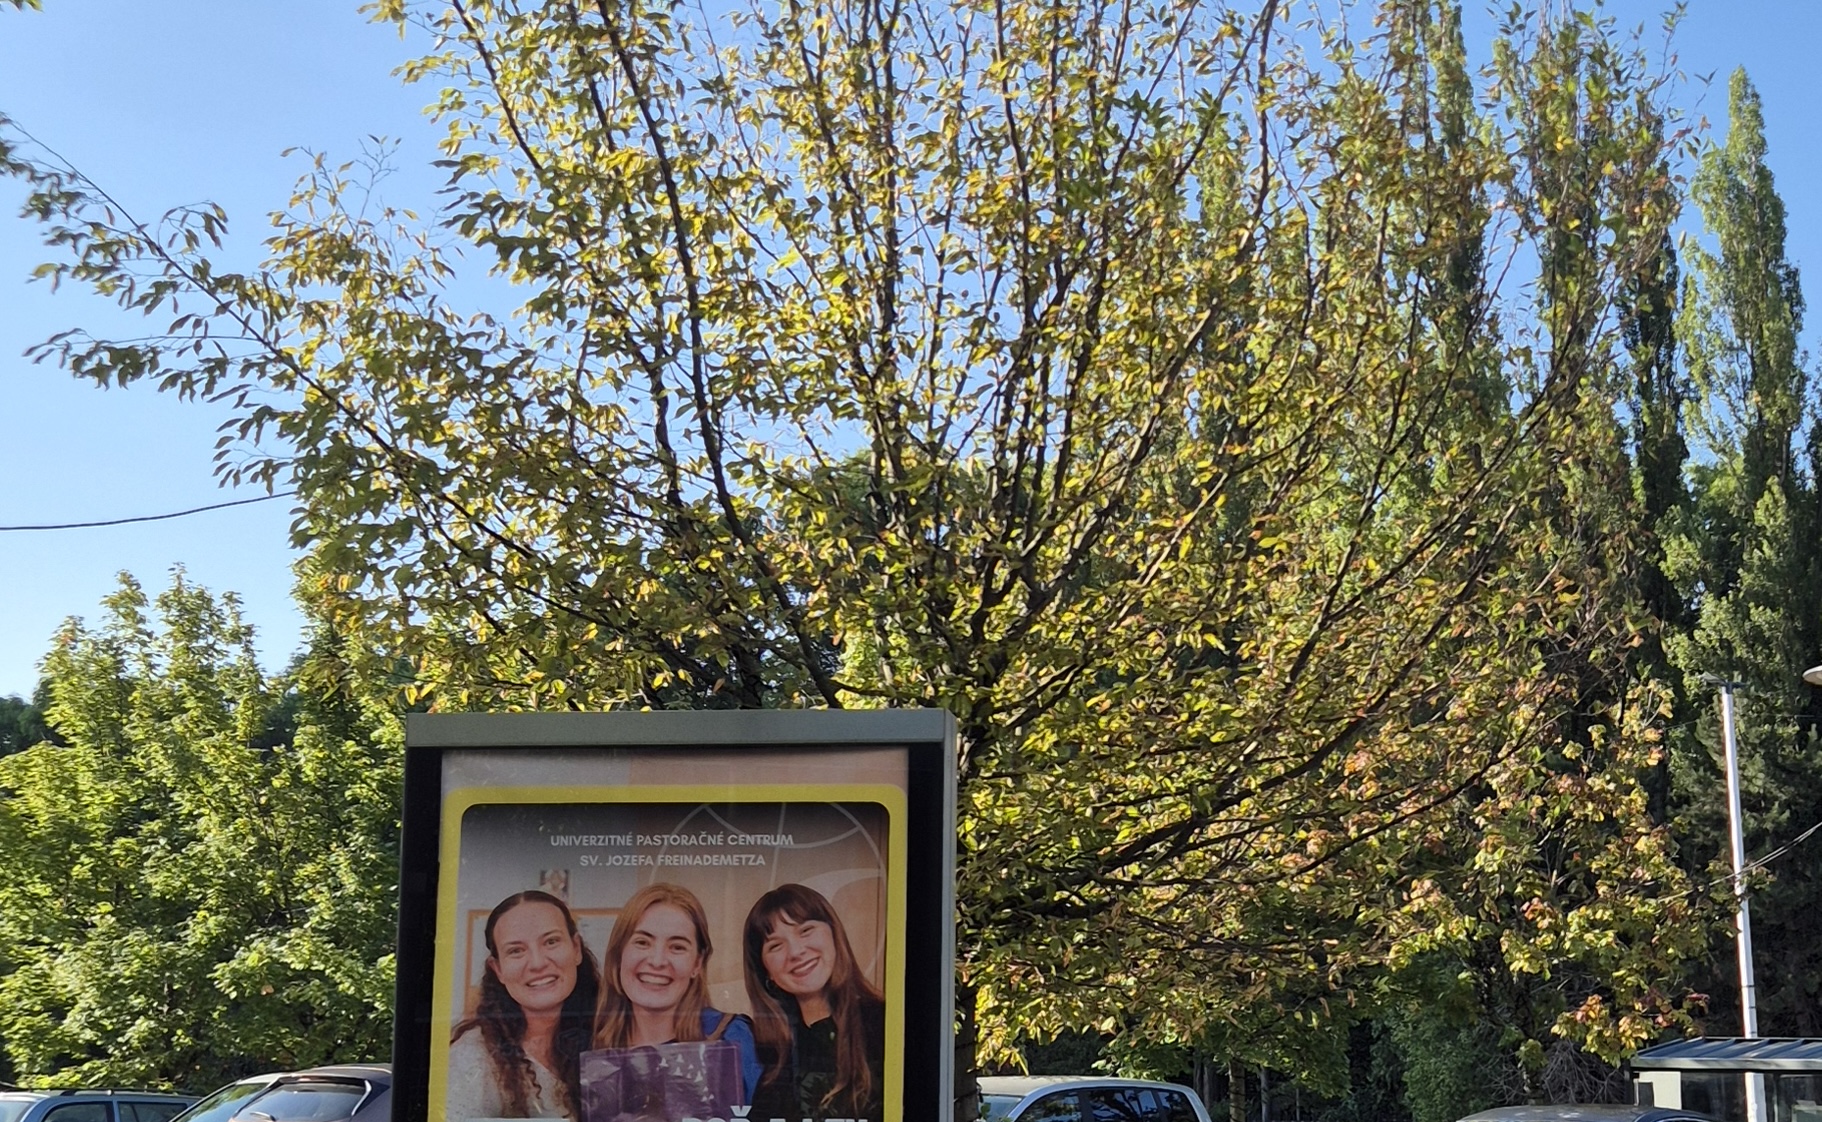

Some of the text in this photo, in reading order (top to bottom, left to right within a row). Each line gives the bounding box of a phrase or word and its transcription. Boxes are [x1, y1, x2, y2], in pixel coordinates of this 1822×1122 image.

[550, 831, 794, 847] UNIVERZITNÉ PASTORAČNÉ CENTRUM
[580, 854, 766, 866] SV. JOZEFA FREINADEMETZA
